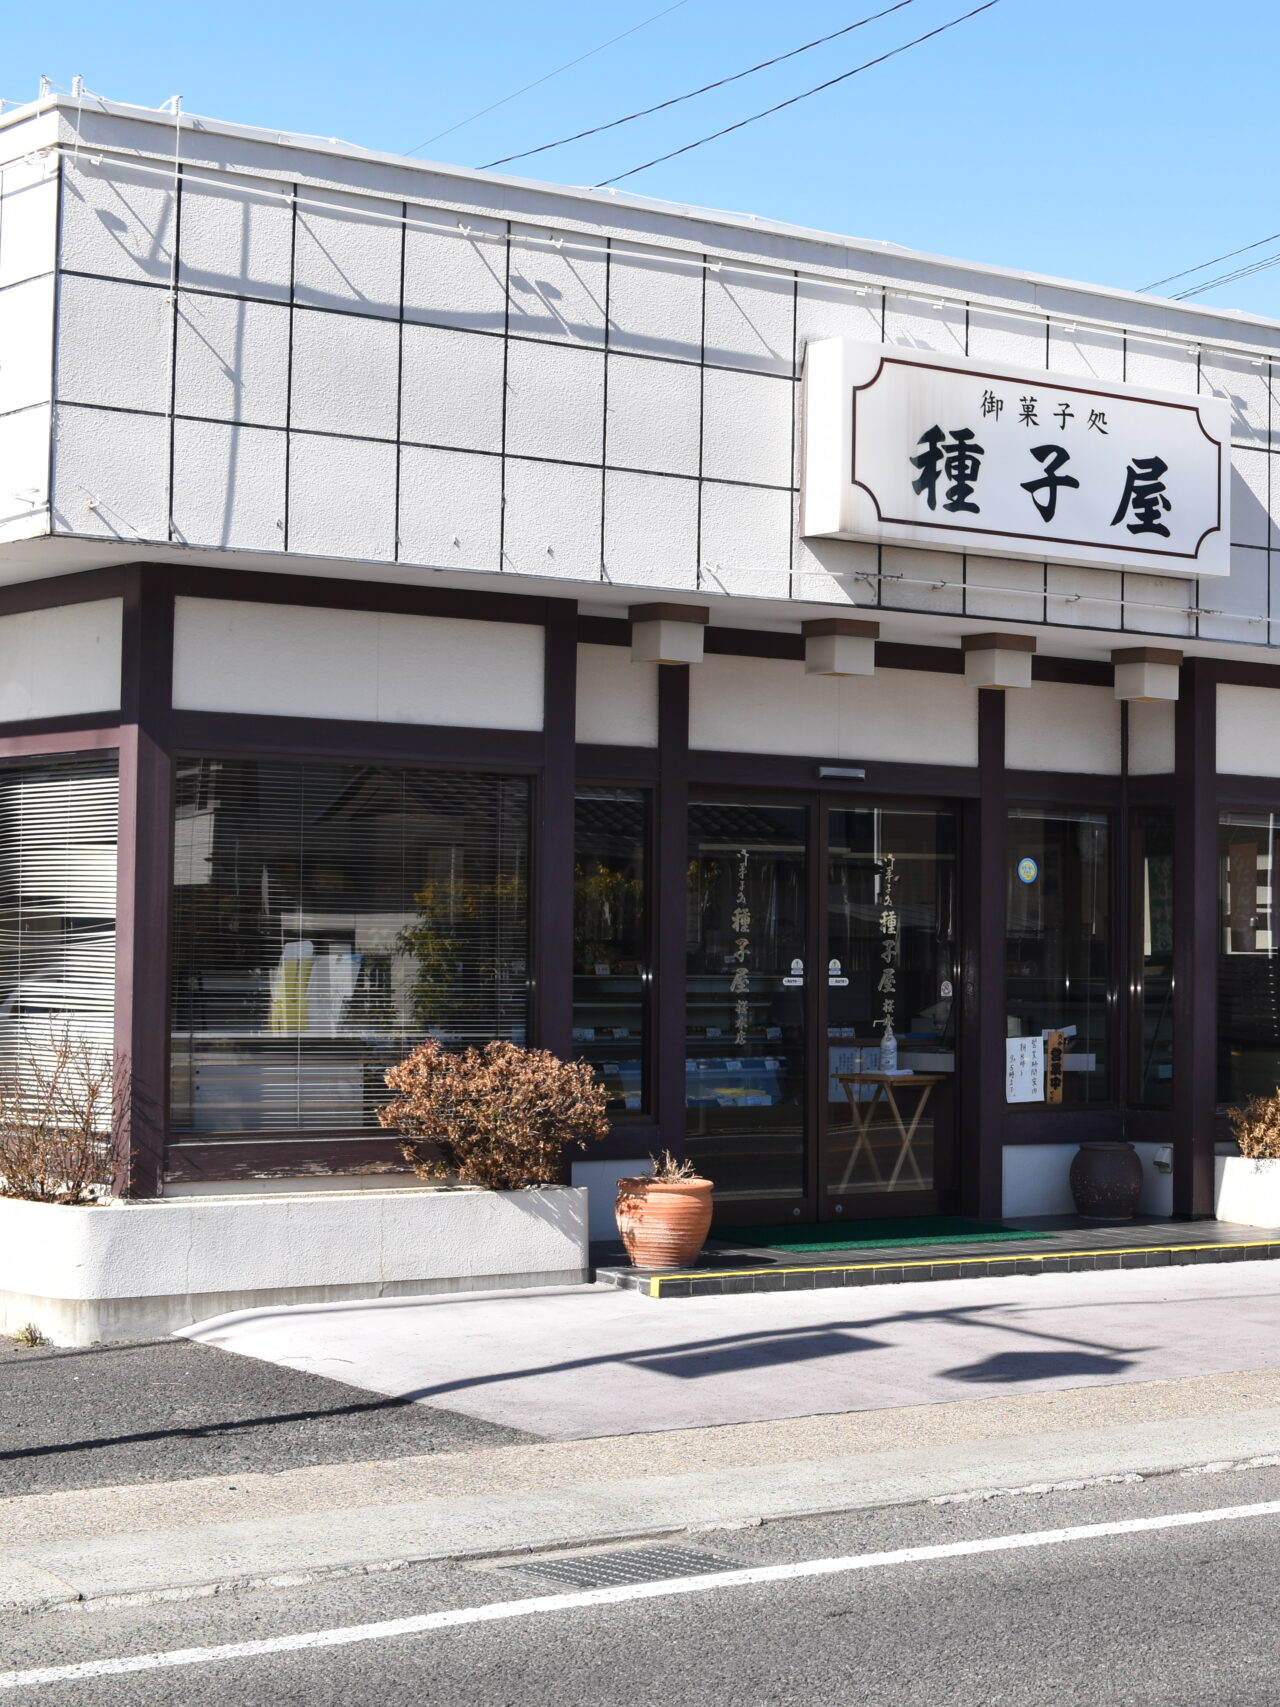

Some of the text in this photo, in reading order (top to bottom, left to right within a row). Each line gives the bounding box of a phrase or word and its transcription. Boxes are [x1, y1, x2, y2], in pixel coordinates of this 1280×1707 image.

[980, 389, 1109, 435] 御菓子処
[909, 424, 1171, 538] 種子屋
[730, 907, 751, 993] 種子屋
[878, 911, 897, 992] 種子屋
[1050, 1047, 1062, 1090] 営業中
